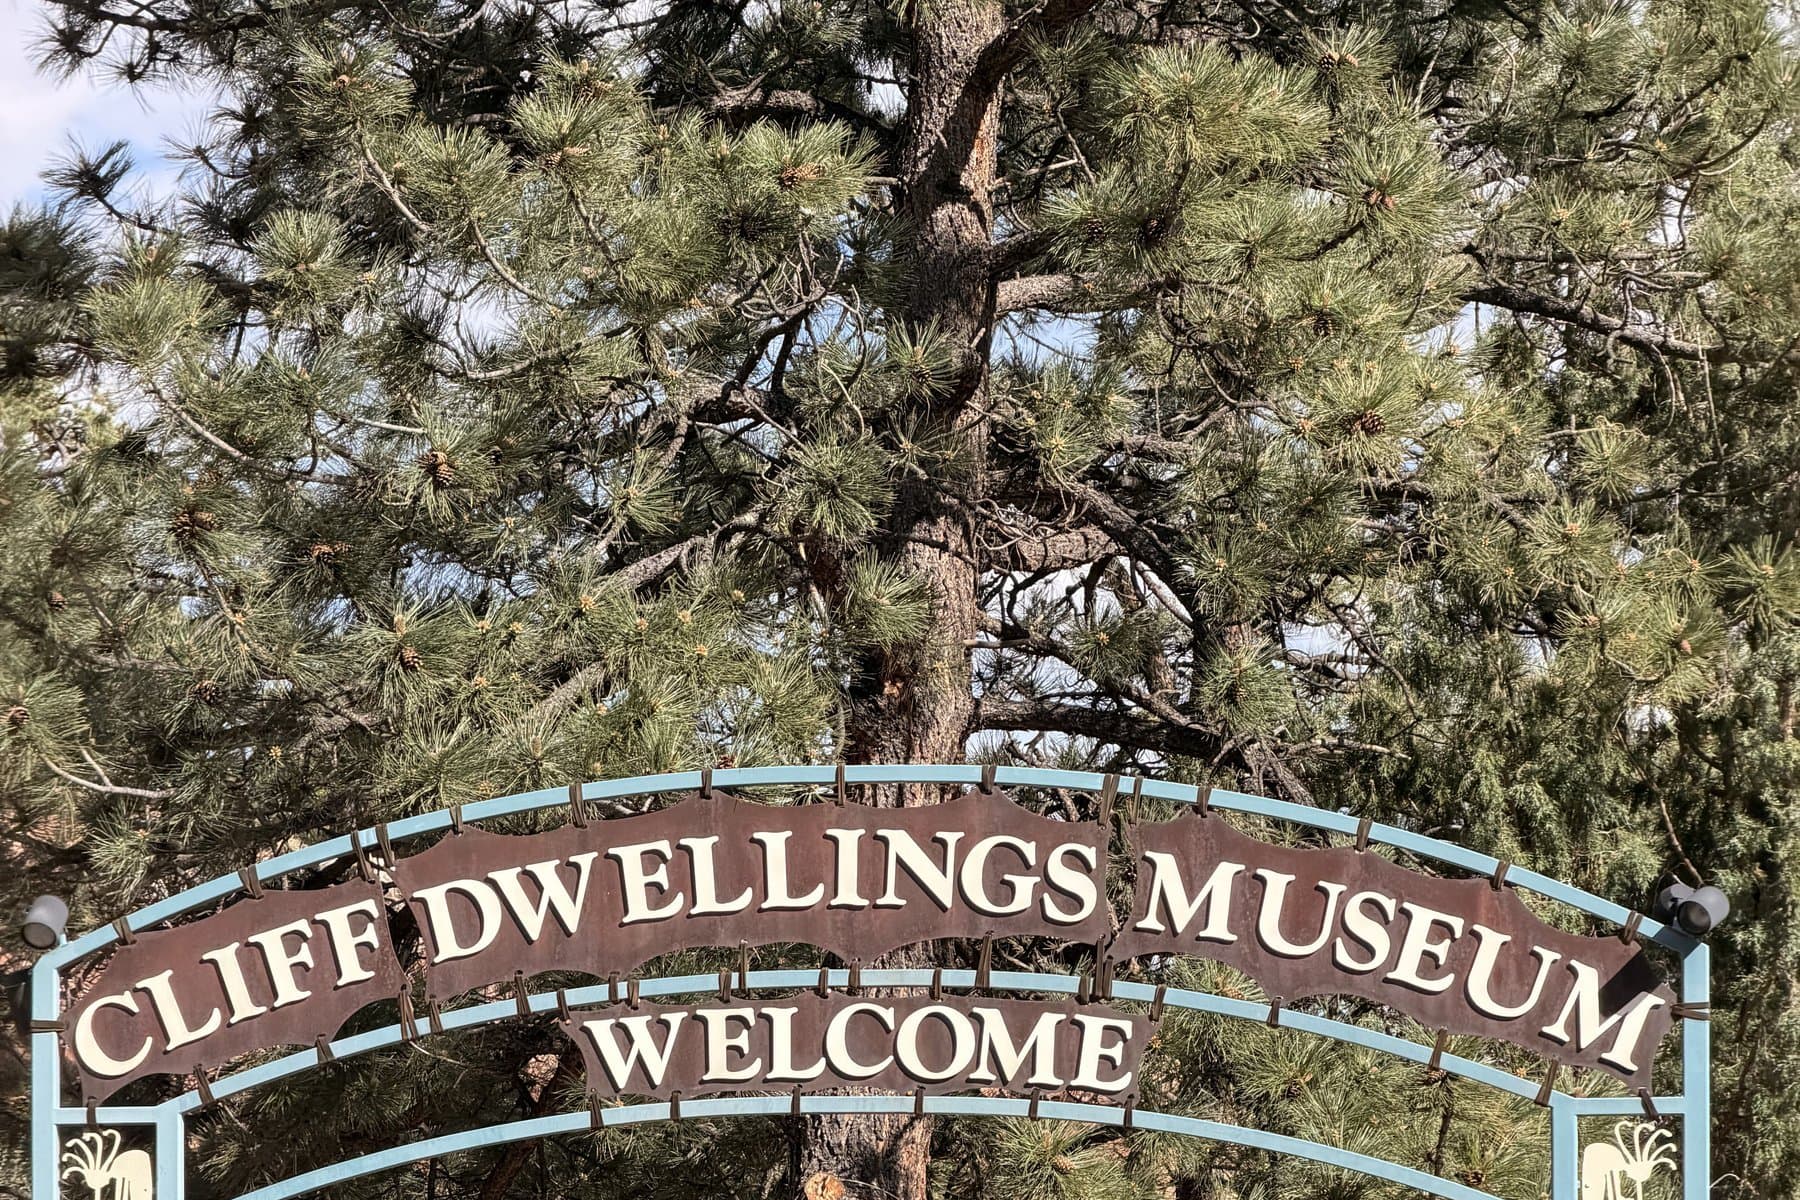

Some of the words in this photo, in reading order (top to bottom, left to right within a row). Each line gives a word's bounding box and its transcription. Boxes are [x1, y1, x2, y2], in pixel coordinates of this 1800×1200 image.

[74, 898, 380, 1077] CLIFF
[412, 828, 1098, 964] DWELLINGS
[1136, 851, 1666, 1072] MUSEUM
[583, 1003, 1134, 1092] WELCOME
